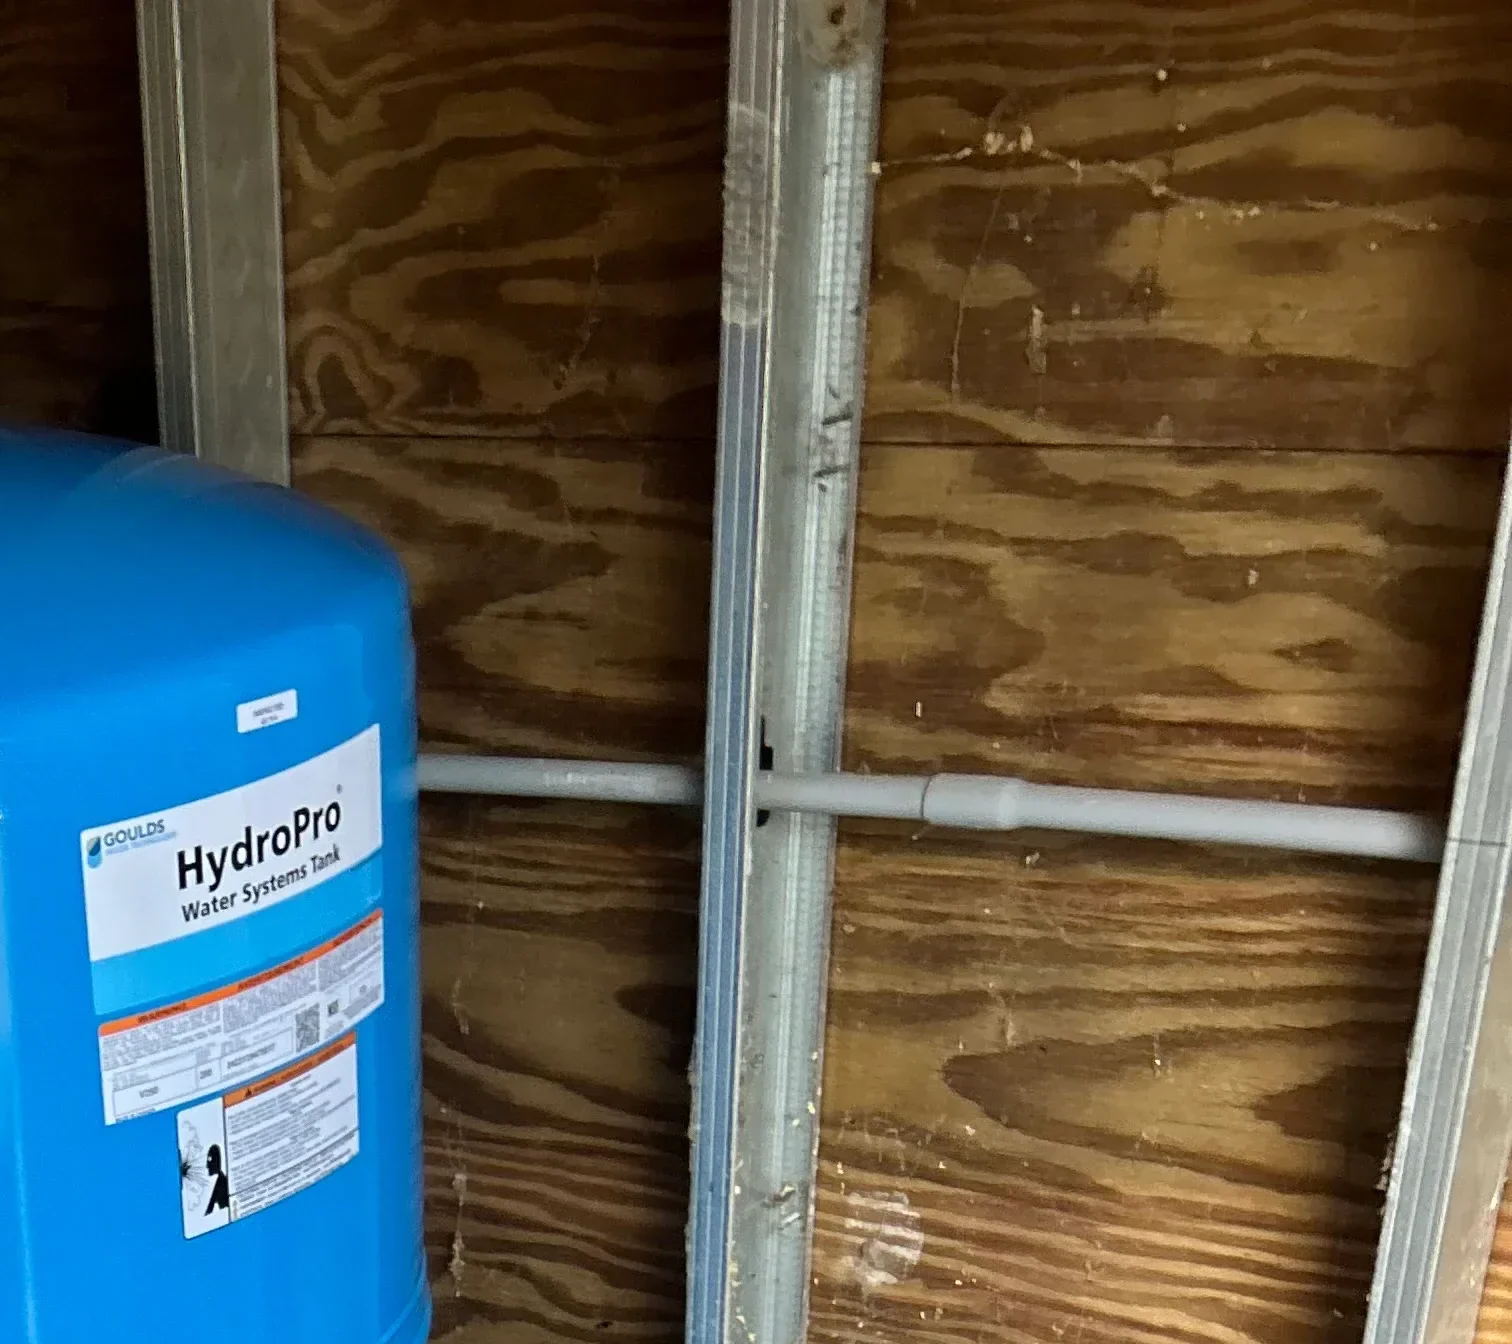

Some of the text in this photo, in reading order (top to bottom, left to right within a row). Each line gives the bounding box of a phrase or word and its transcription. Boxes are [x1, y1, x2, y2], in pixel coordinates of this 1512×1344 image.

[103, 819, 165, 847] GOULDS
[181, 843, 341, 922] Water Systems Tank
